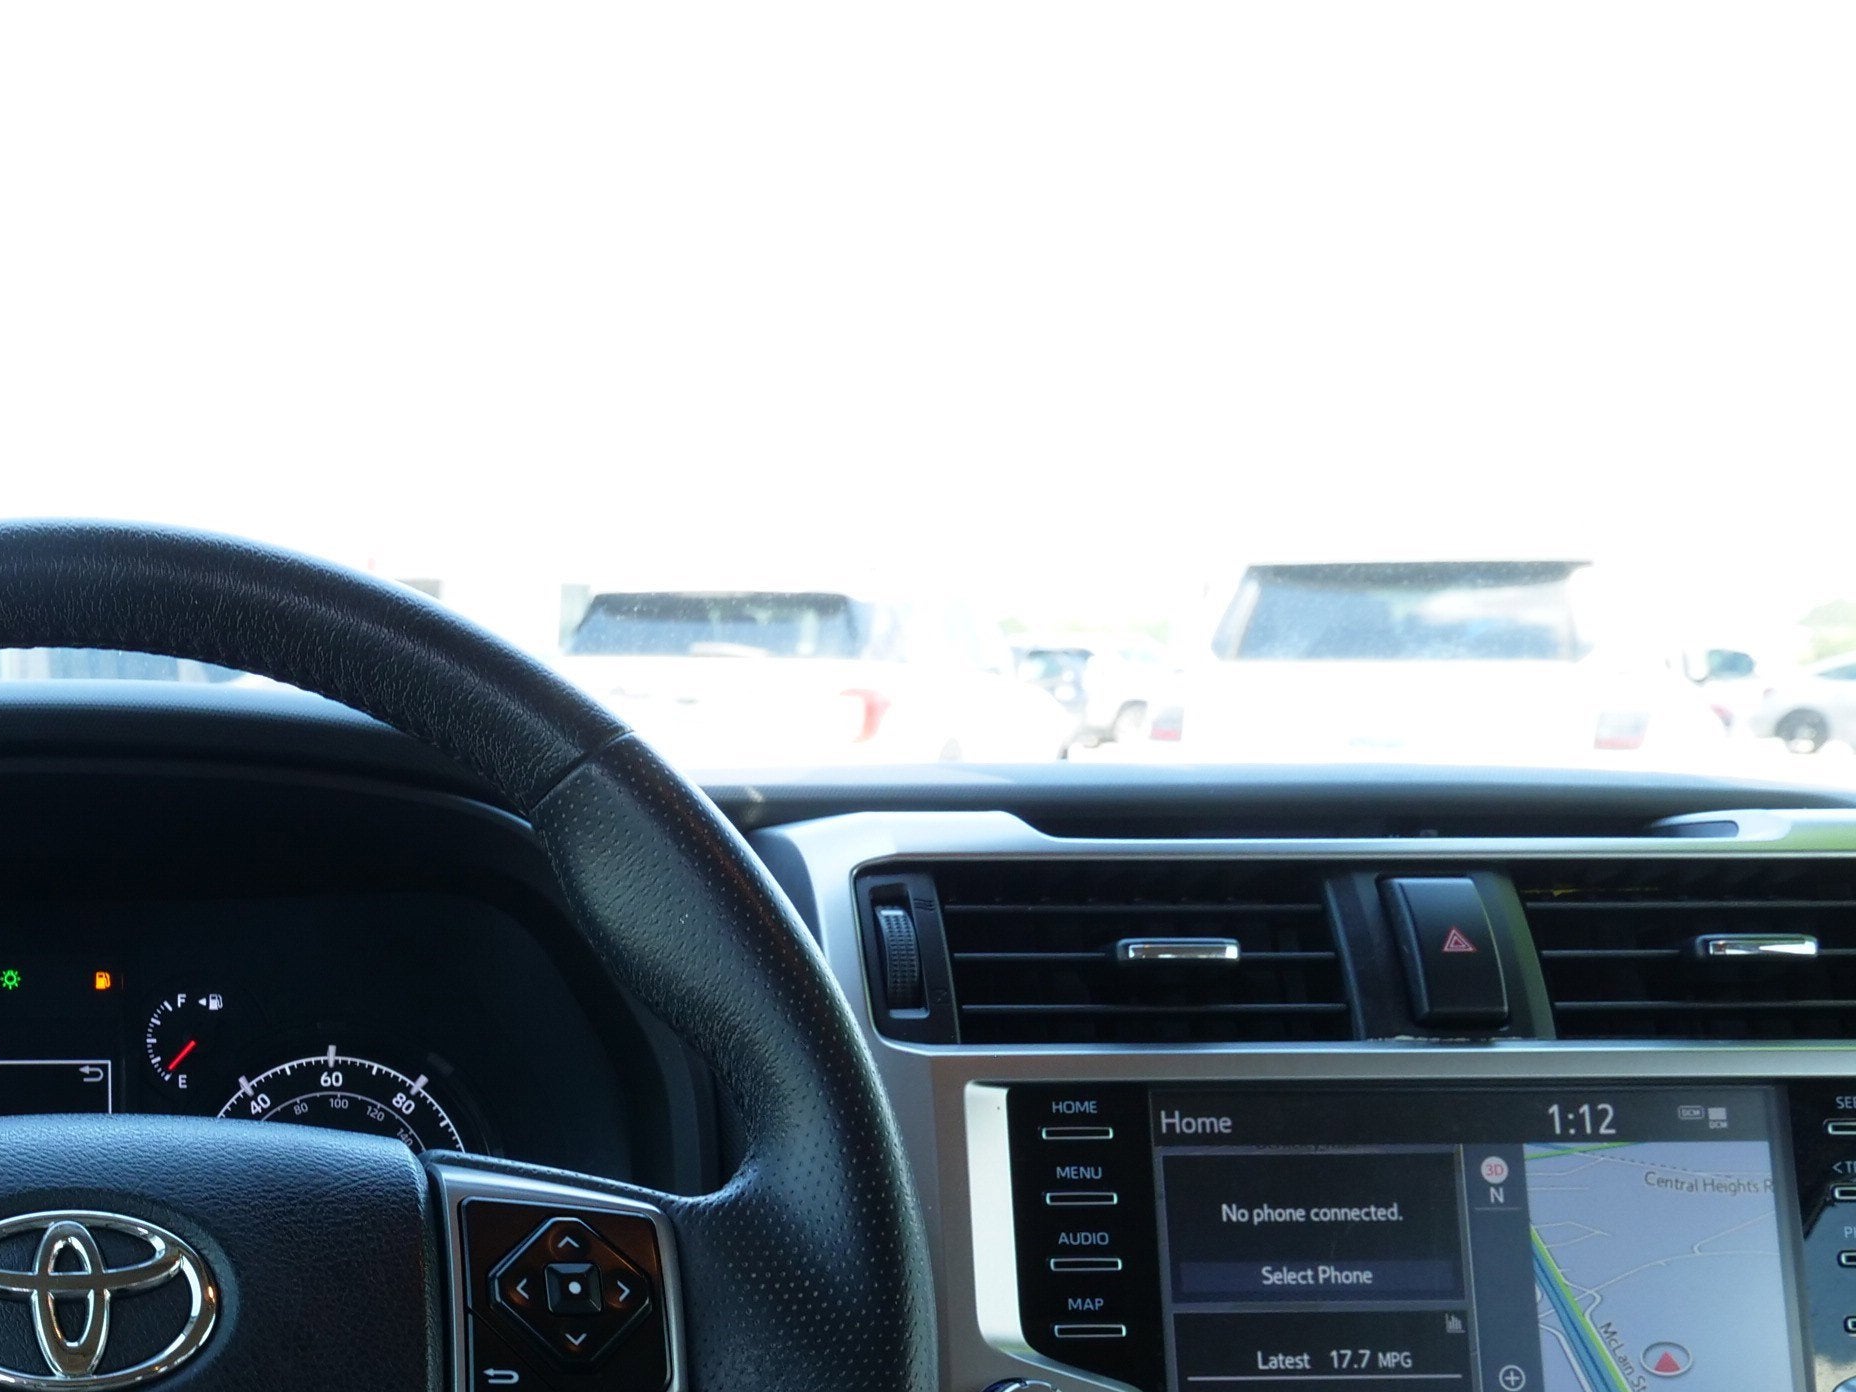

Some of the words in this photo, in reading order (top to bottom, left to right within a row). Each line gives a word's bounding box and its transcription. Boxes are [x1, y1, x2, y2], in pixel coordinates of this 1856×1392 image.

[177, 993, 187, 1008] F
[178, 1074, 188, 1089] E
[320, 1071, 343, 1088] 60
[249, 1093, 271, 1116] 40
[293, 1101, 309, 1116] 80
[329, 1098, 349, 1110] 100
[391, 1091, 415, 1116] 80
[1052, 1100, 1098, 1114] HOME
[366, 1105, 385, 1122] 120
[1548, 1103, 1617, 1135] 1:12
[1160, 1110, 1233, 1134] Home
[1056, 1166, 1102, 1180] MENU
[1486, 1163, 1504, 1176] 3D
[1645, 1171, 1699, 1192] Central
[1703, 1176, 1759, 1196] Heights
[1489, 1187, 1505, 1203] N
[1221, 1203, 1249, 1222] No
[1252, 1203, 1306, 1226] phone
[1310, 1202, 1403, 1222] connected.
[1058, 1232, 1109, 1245] AUDIO
[1261, 1266, 1314, 1285] Select
[1318, 1265, 1373, 1284] Phone
[1068, 1298, 1104, 1311] MAP
[1257, 1350, 1312, 1370] Latest
[1330, 1349, 1371, 1369] 17.7
[1377, 1351, 1413, 1368] MPG
